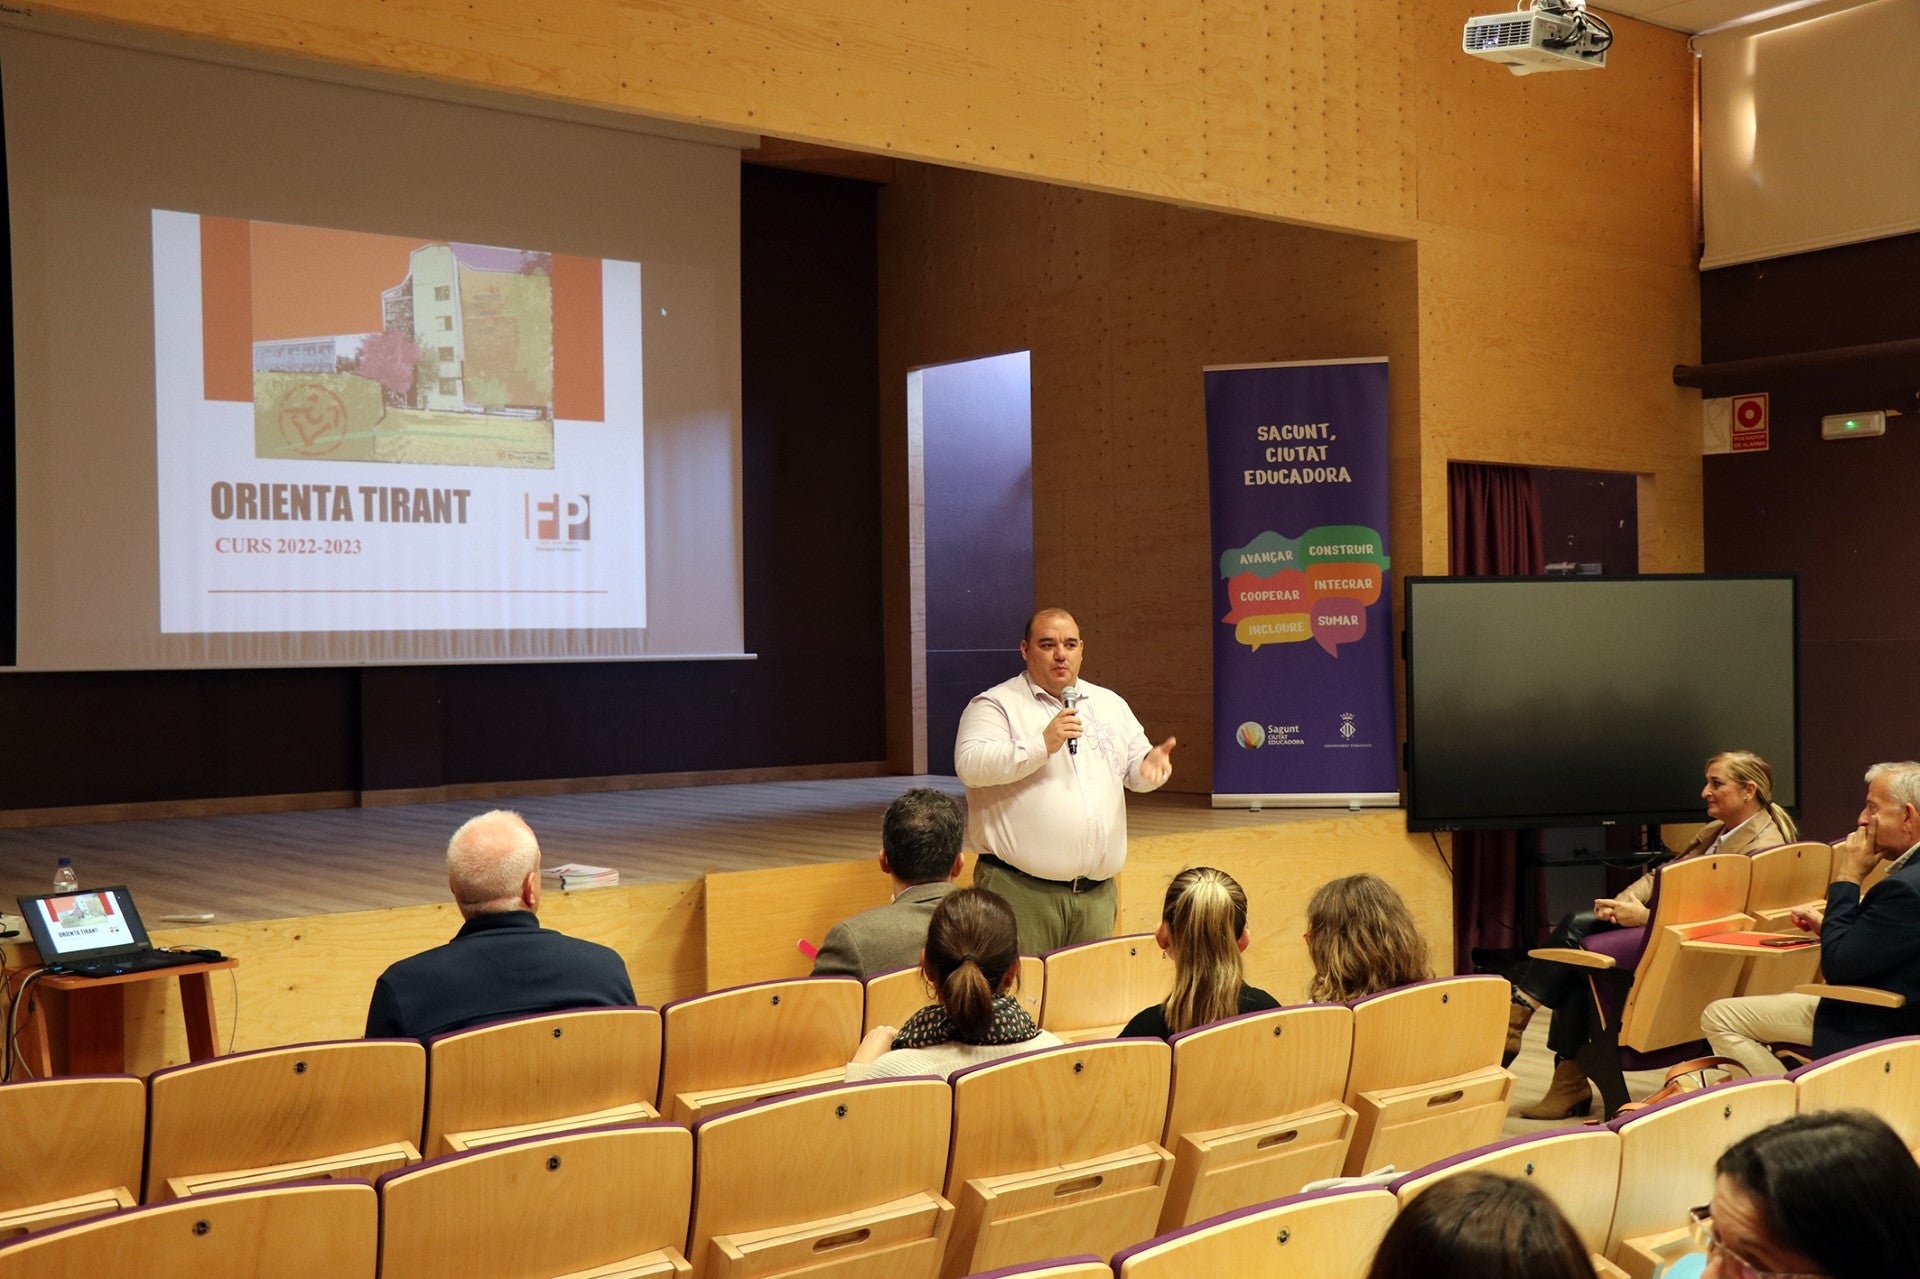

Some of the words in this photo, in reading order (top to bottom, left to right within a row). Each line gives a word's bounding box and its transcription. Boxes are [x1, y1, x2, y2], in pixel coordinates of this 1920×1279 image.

[1256, 422, 1337, 441] SAGUNT,
[1265, 445, 1329, 462] CIUTAT
[1243, 466, 1352, 485] EDUCADORA
[210, 480, 354, 522] ORIENTA
[358, 486, 471, 524] TIRANT
[215, 537, 272, 554] CURS
[276, 538, 362, 554] 2022-2023
[1308, 543, 1374, 556] CONSTRUIR
[1239, 550, 1294, 565] AVANÇAR
[1313, 578, 1373, 590] INTEGRAR
[1239, 589, 1301, 602] COOPERAR
[1317, 614, 1359, 626] SUMAR
[1248, 621, 1305, 635] INCLOURE
[1267, 724, 1300, 735] Sagunt
